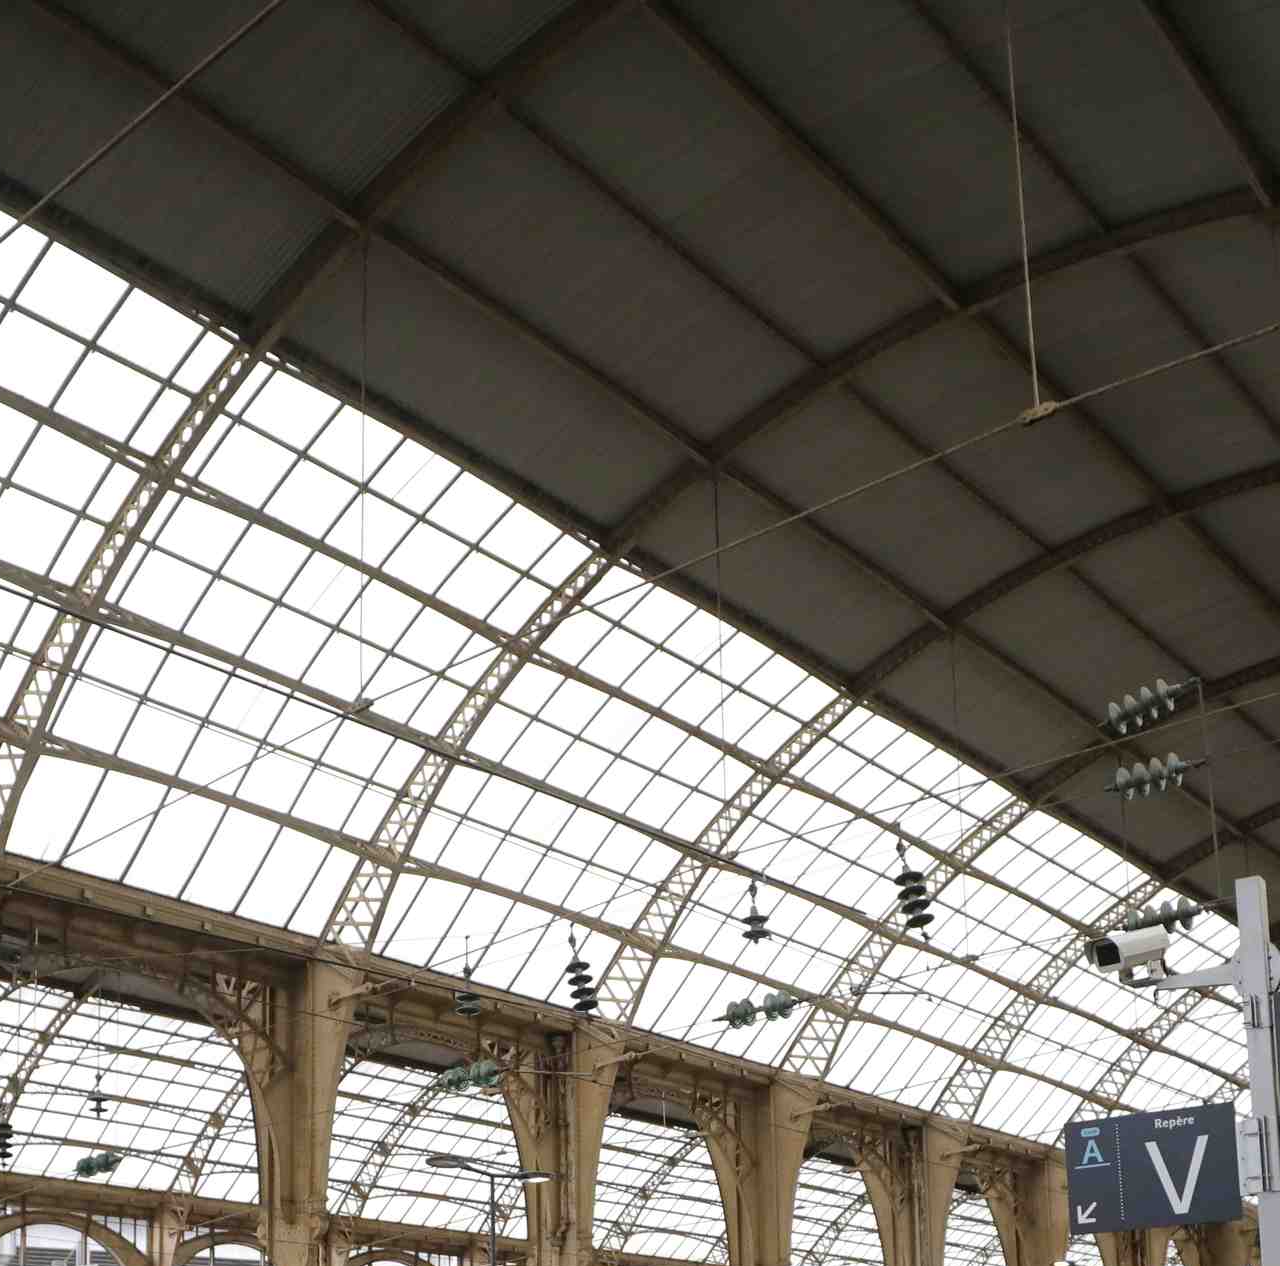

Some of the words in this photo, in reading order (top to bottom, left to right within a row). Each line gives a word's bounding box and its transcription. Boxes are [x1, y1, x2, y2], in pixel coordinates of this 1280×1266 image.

[1154, 1116, 1195, 1130] Repère
[1081, 1139, 1104, 1165] A
[1144, 1134, 1209, 1215] V
